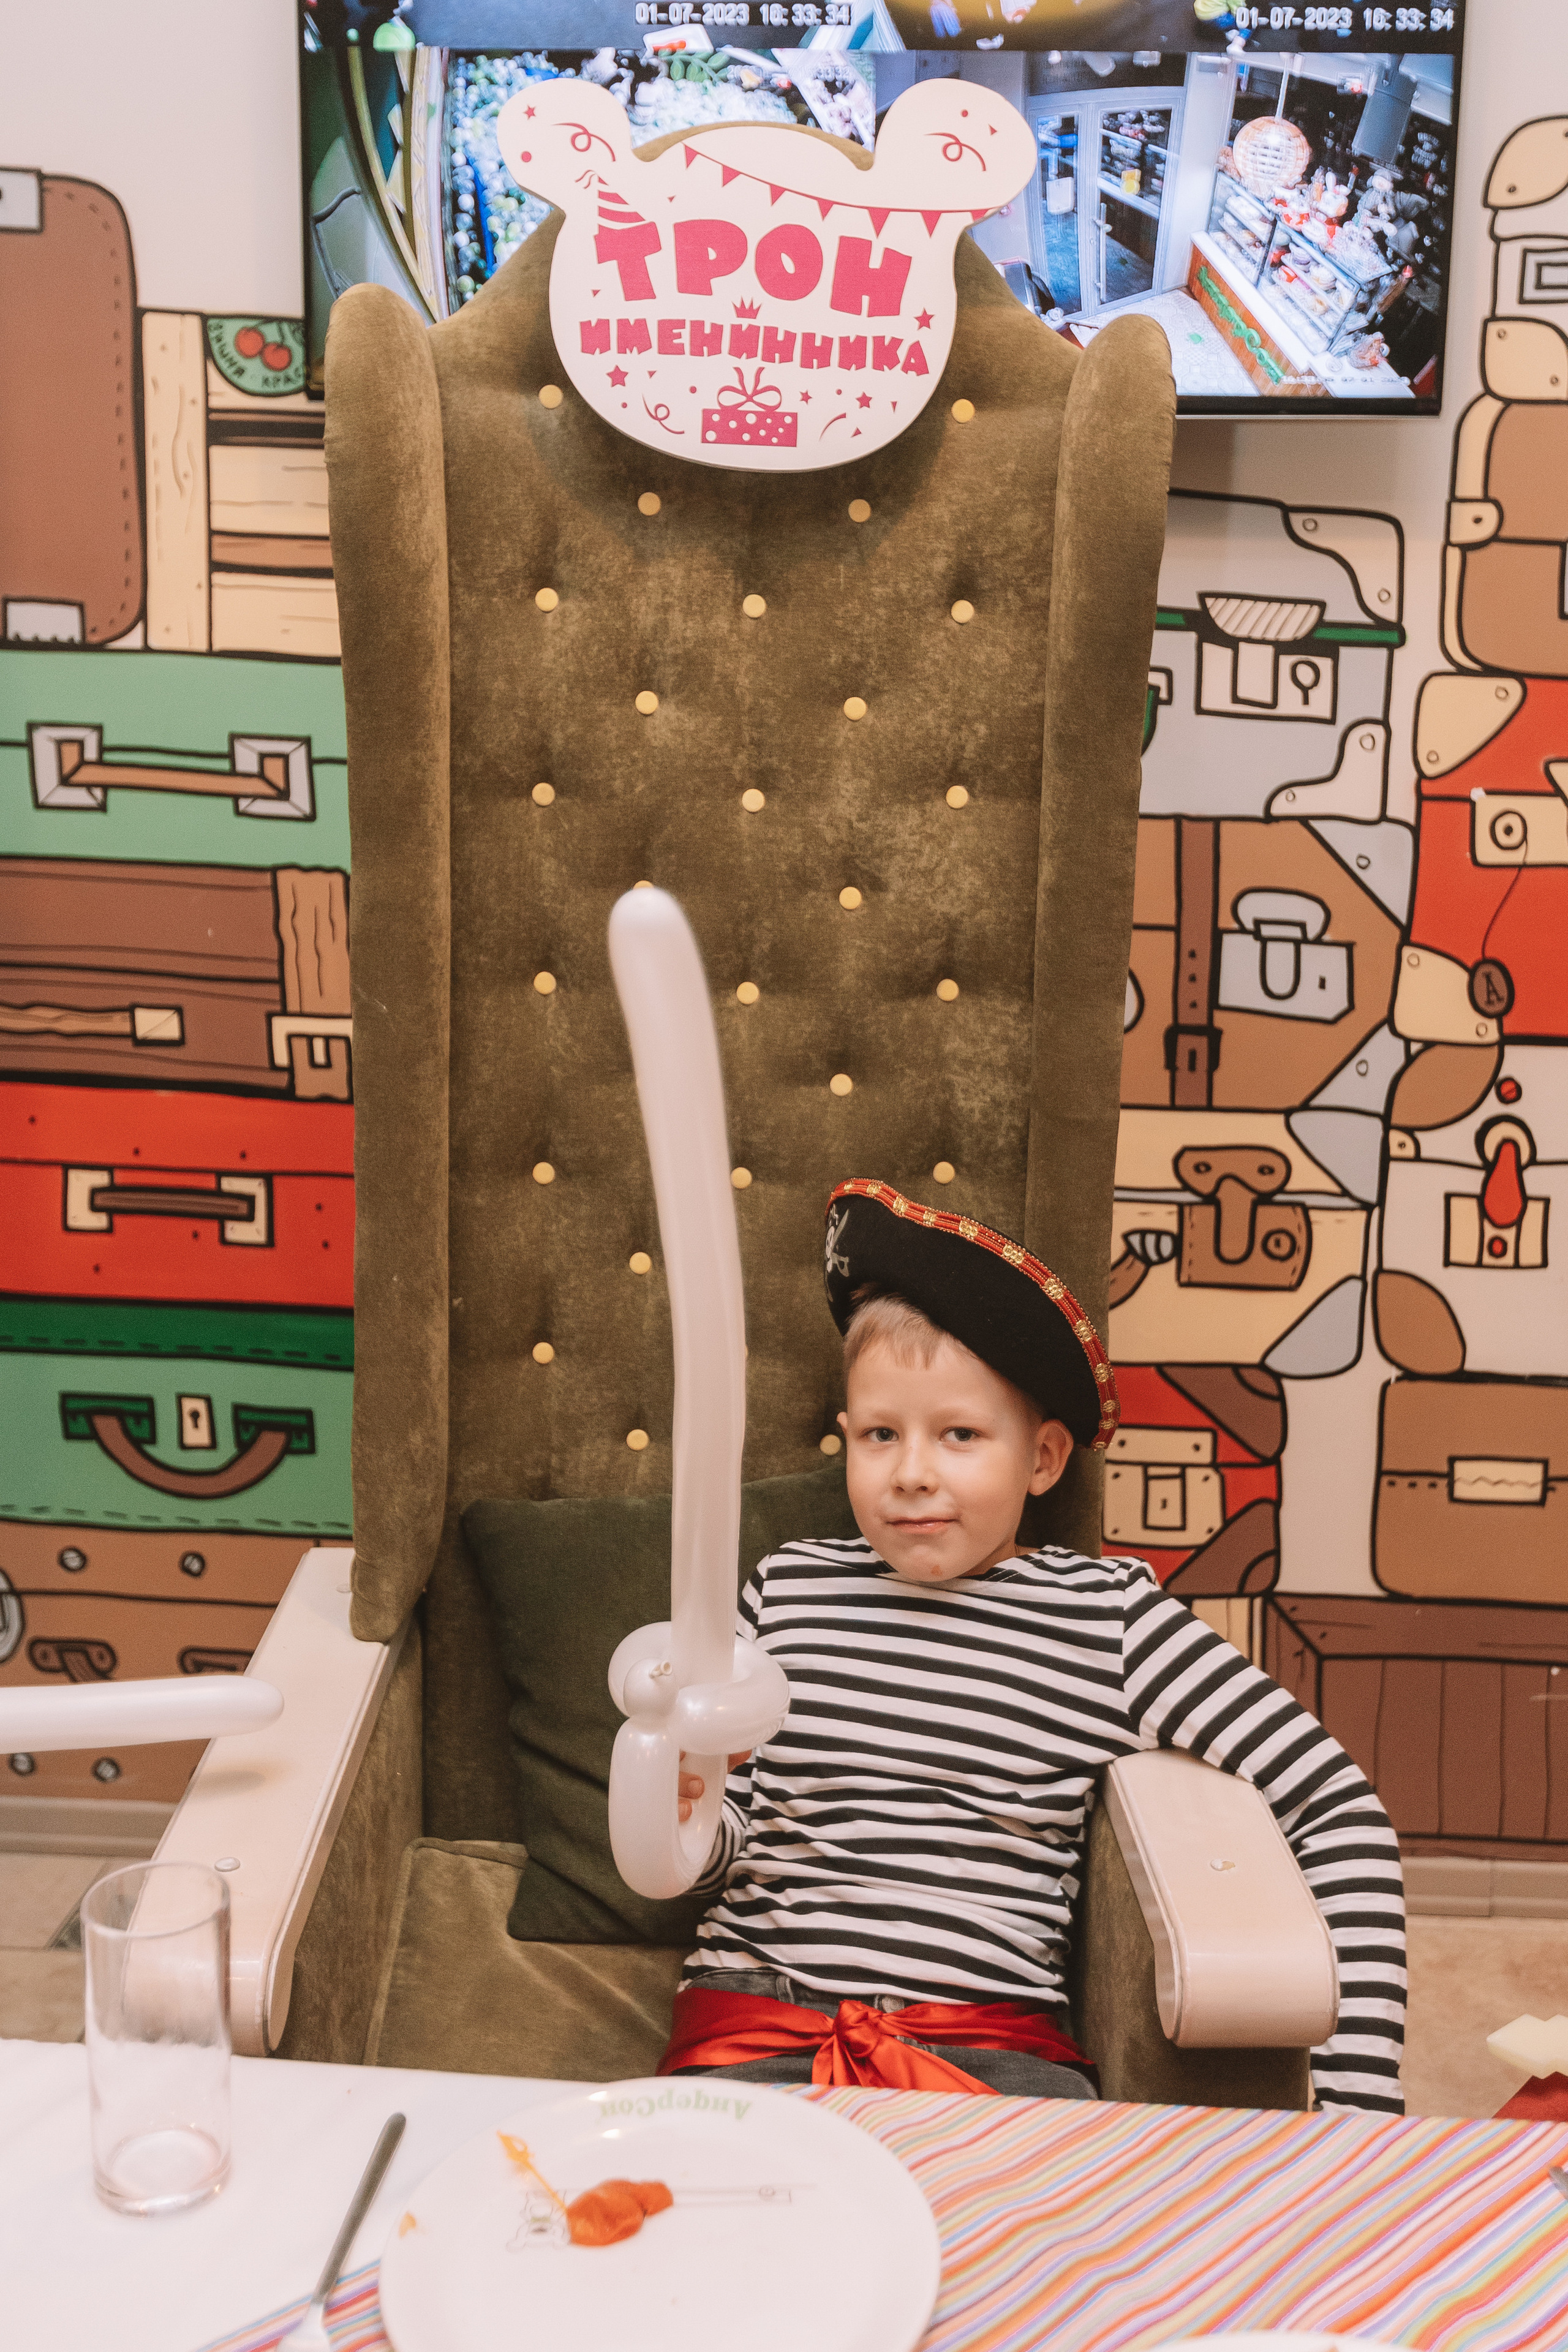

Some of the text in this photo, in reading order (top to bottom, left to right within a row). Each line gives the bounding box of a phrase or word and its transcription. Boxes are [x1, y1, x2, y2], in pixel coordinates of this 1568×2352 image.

[635, 2, 750, 26] 01-07-2023
[1236, 7, 1352, 30] 01-07-2023
[594, 219, 912, 317] ТРОН
[579, 318, 929, 376] ИМЕНИННИКА
